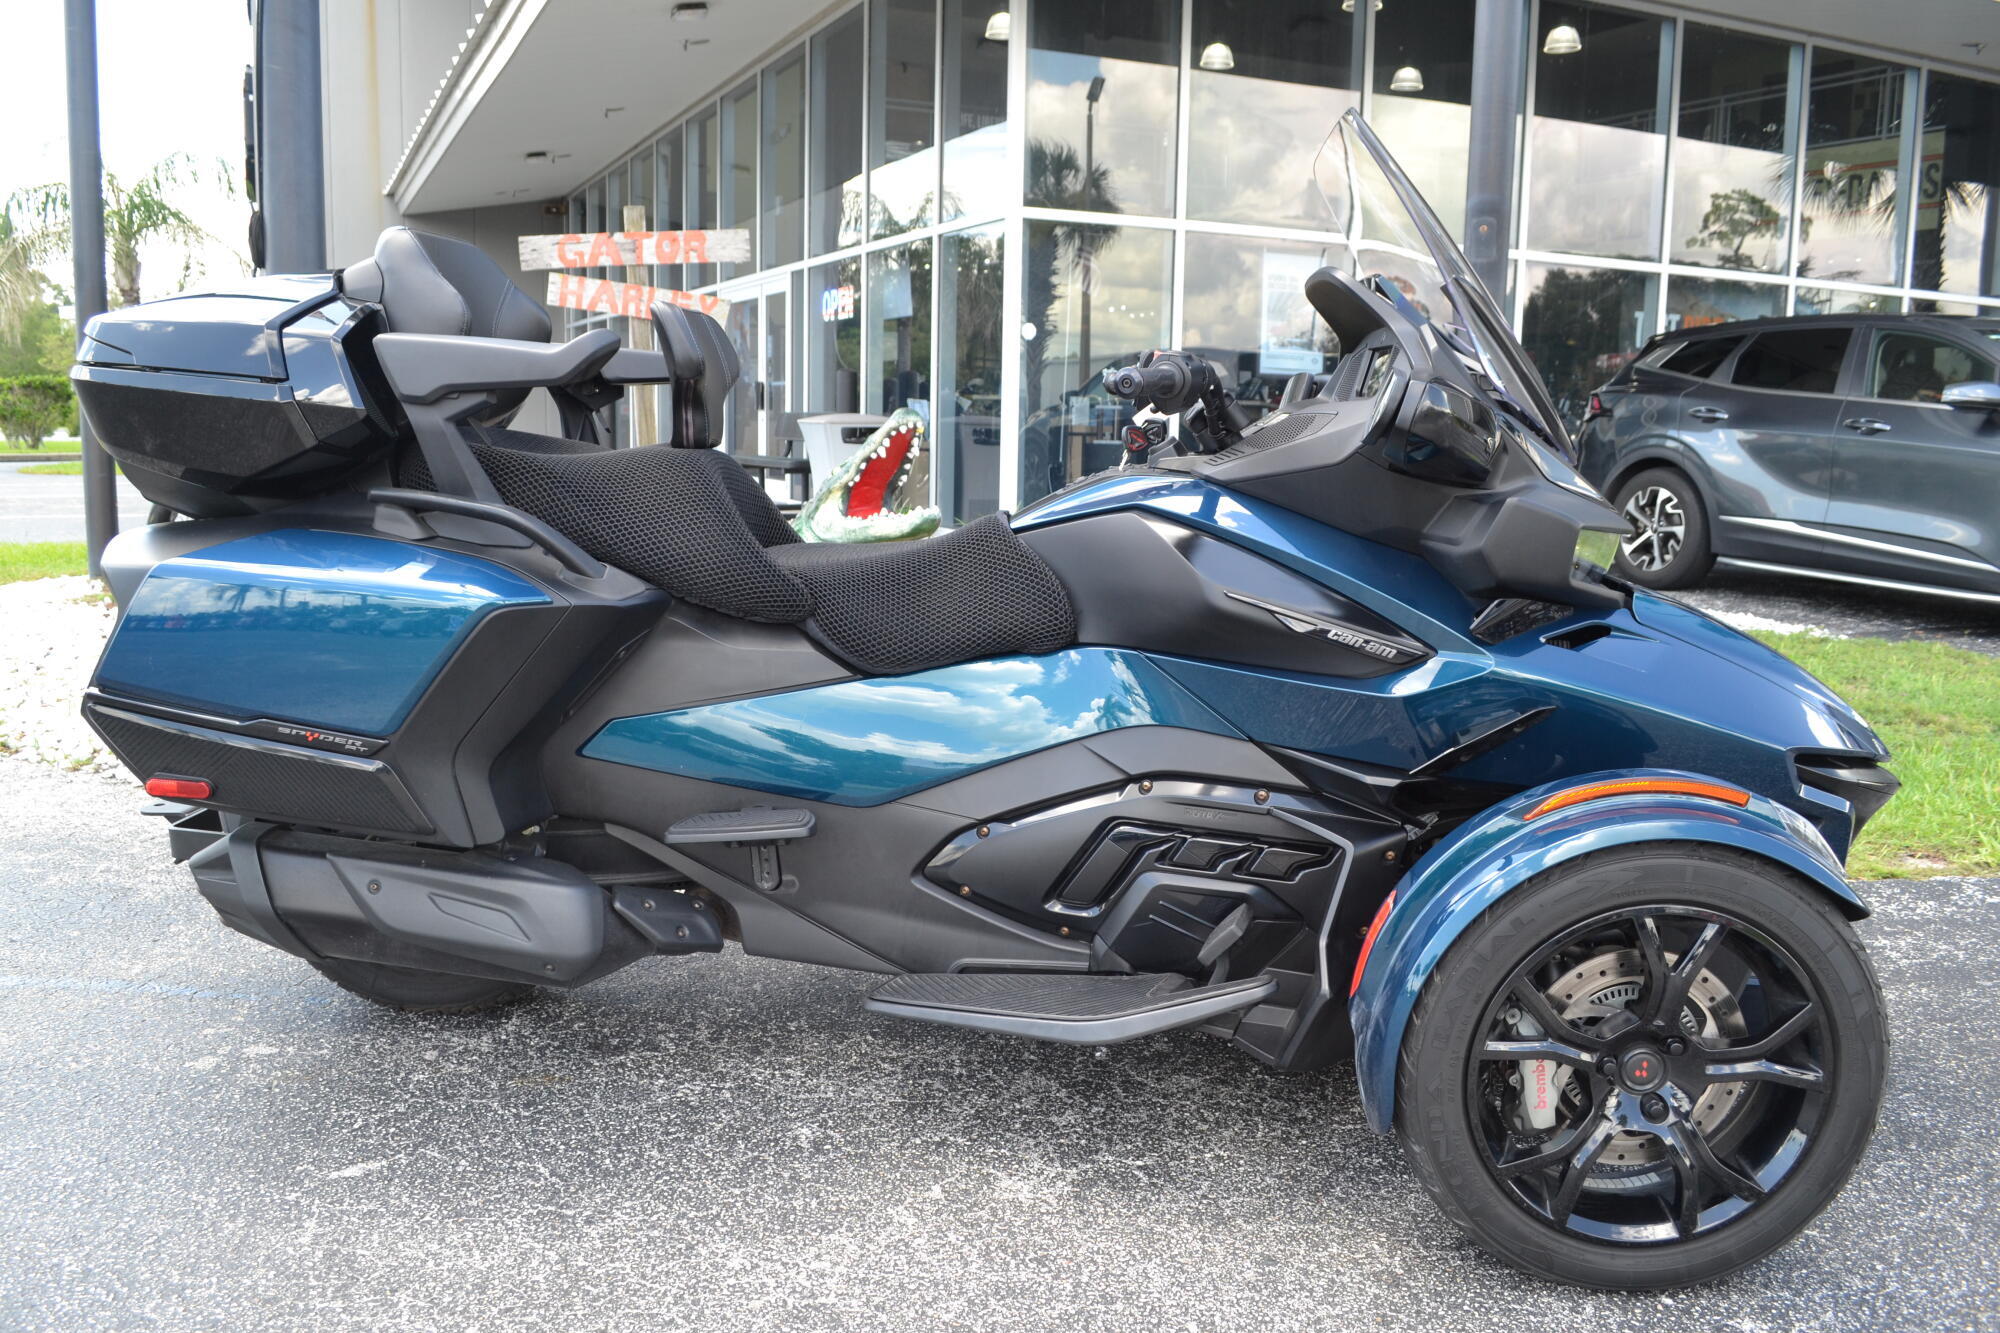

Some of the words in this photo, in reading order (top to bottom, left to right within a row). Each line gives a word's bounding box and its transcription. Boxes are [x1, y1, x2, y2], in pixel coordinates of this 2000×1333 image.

[556, 230, 709, 269] GATOR
[822, 285, 854, 322] OPEN
[1327, 629, 1398, 659] can-am
[278, 727, 363, 746] SPYDER
[345, 744, 368, 752] RT
